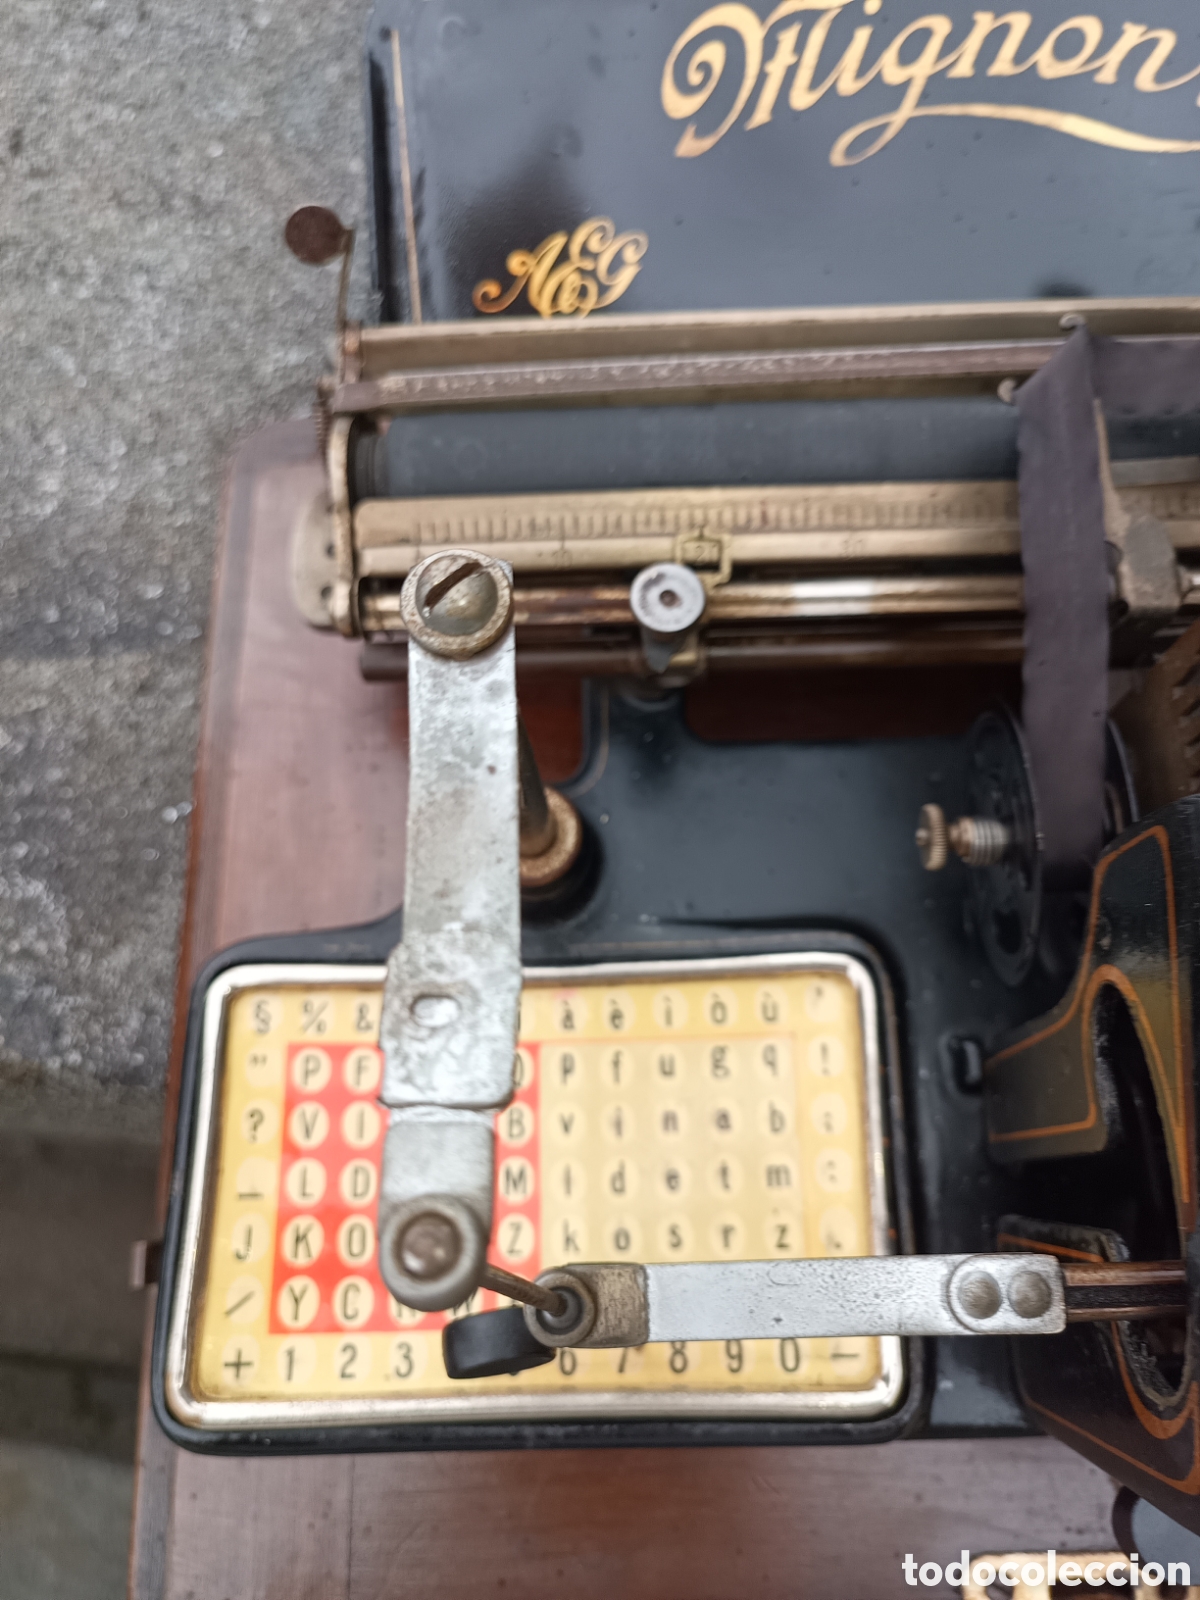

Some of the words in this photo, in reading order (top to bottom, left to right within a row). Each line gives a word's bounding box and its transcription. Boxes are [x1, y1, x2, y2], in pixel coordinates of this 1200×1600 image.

[660, 0, 1200, 167] Mignon
[472, 215, 649, 319] AEG
[303, 1055, 321, 1086] P
[355, 1055, 371, 1087] F
[559, 1052, 576, 1086] p
[611, 1049, 624, 1086] f
[658, 1053, 676, 1080] u
[709, 1044, 731, 1080] g
[761, 1043, 779, 1079] q
[248, 1109, 265, 1142] ?
[303, 1111, 319, 1147] V
[508, 1106, 525, 1140] B
[559, 1112, 576, 1135] v
[662, 1110, 680, 1133] n
[715, 1108, 731, 1131] a
[768, 1101, 786, 1134] b
[303, 1167, 315, 1198] L
[351, 1165, 371, 1197] D
[504, 1167, 527, 1197] M
[610, 1159, 626, 1195] d
[664, 1167, 681, 1192] e
[718, 1160, 731, 1191] t
[765, 1163, 792, 1188] m
[235, 1224, 253, 1261] J
[292, 1223, 313, 1260] K
[508, 1221, 523, 1255] Z
[563, 1219, 580, 1253] k
[668, 1223, 684, 1249] s
[722, 1224, 736, 1250] r
[774, 1223, 791, 1250] z
[289, 1283, 308, 1321] Y
[343, 1283, 361, 1321] C
[286, 1346, 296, 1381] 1
[341, 1343, 357, 1378] 2
[395, 1342, 414, 1378] 3
[669, 1341, 688, 1373] 8
[726, 1339, 744, 1373] 9
